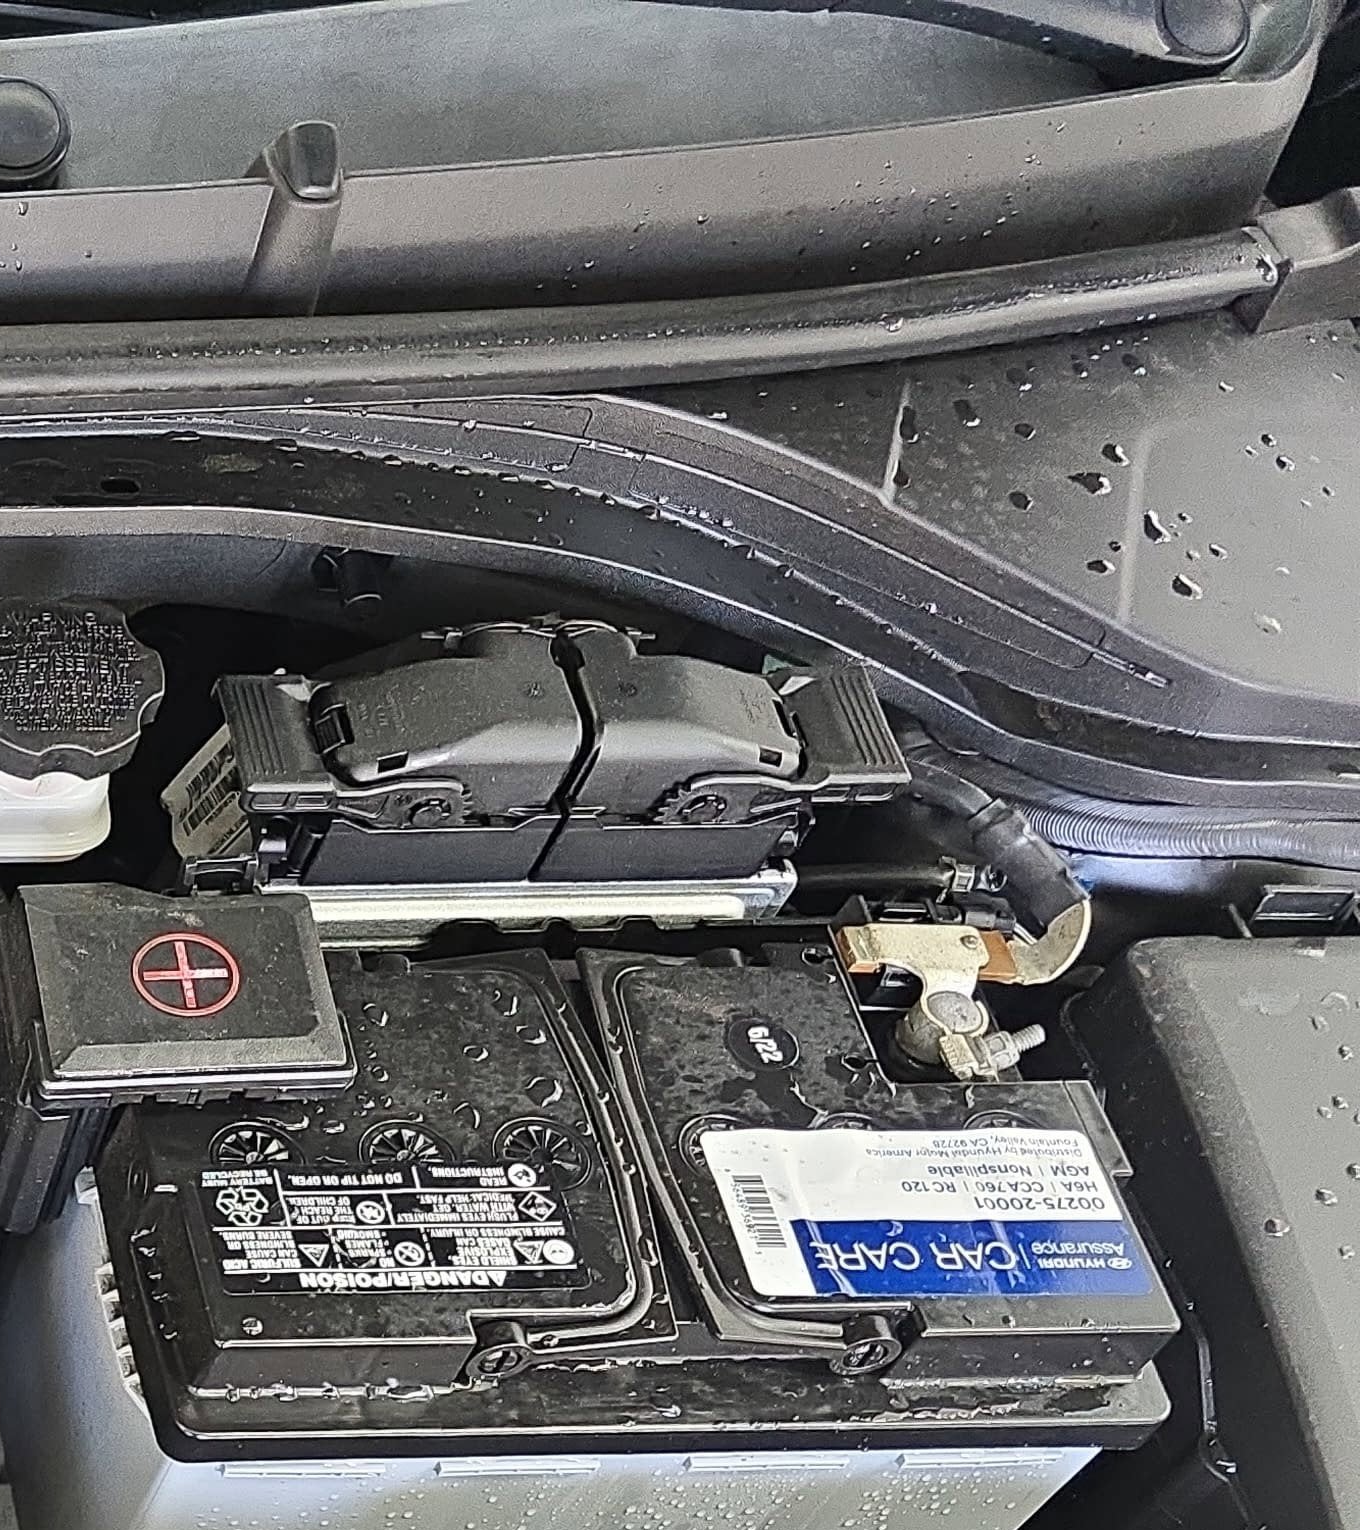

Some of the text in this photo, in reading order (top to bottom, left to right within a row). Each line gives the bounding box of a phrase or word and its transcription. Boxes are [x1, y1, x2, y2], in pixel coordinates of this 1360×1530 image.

[747, 1026, 784, 1064] 6/22
[968, 1137, 988, 1148] CA
[990, 1135, 1026, 1147] Valley,
[1029, 1137, 1079, 1147] Fountain
[865, 1147, 912, 1159] America
[951, 1144, 1003, 1159] Hyundai
[1004, 1145, 1018, 1158] by
[1020, 1147, 1083, 1158] Distributed
[927, 1163, 1090, 1177] AGM Nonspillable
[322, 1174, 340, 1186] OR
[340, 1173, 359, 1186] TIP
[359, 1173, 384, 1185] NOT
[385, 1172, 403, 1185] DO
[478, 1176, 509, 1187] READ
[1061, 1181, 1098, 1194] H6A
[337, 1196, 351, 1207] OF
[444, 1193, 468, 1204] HELP
[468, 1193, 514, 1203] MEDICAL
[973, 1196, 1106, 1211] 00275-20001
[301, 1206, 354, 1216] THE REACH
[432, 1203, 450, 1213] GET
[487, 1202, 515, 1212] WITH
[295, 1215, 309, 1225] OF
[309, 1214, 331, 1224] OUT
[395, 1211, 519, 1223] FLUSH EYES IMMEDIATELY
[256, 1230, 293, 1241] SEVERE
[426, 1227, 566, 1238] CAUSE BLINDNESS OR INJURY.
[226, 1239, 296, 1251] BLINDNESS OR
[344, 1238, 384, 1249] FLAMES
[455, 1237, 511, 1248] GASES CAN
[1031, 1240, 1125, 1255] Assurance
[244, 1249, 298, 1259] CAN CAUSE
[347, 1247, 386, 1258] SPARKS
[456, 1246, 512, 1257] EXPLOSIVE
[809, 1240, 1018, 1271] CAR CARE
[222, 1258, 302, 1270] SULFURIC ACID
[378, 1257, 395, 1268] NO
[481, 1256, 518, 1267] SHIELD
[1036, 1256, 1105, 1270] HYUNDAI
[297, 1271, 490, 1288] DANGER/POISON
